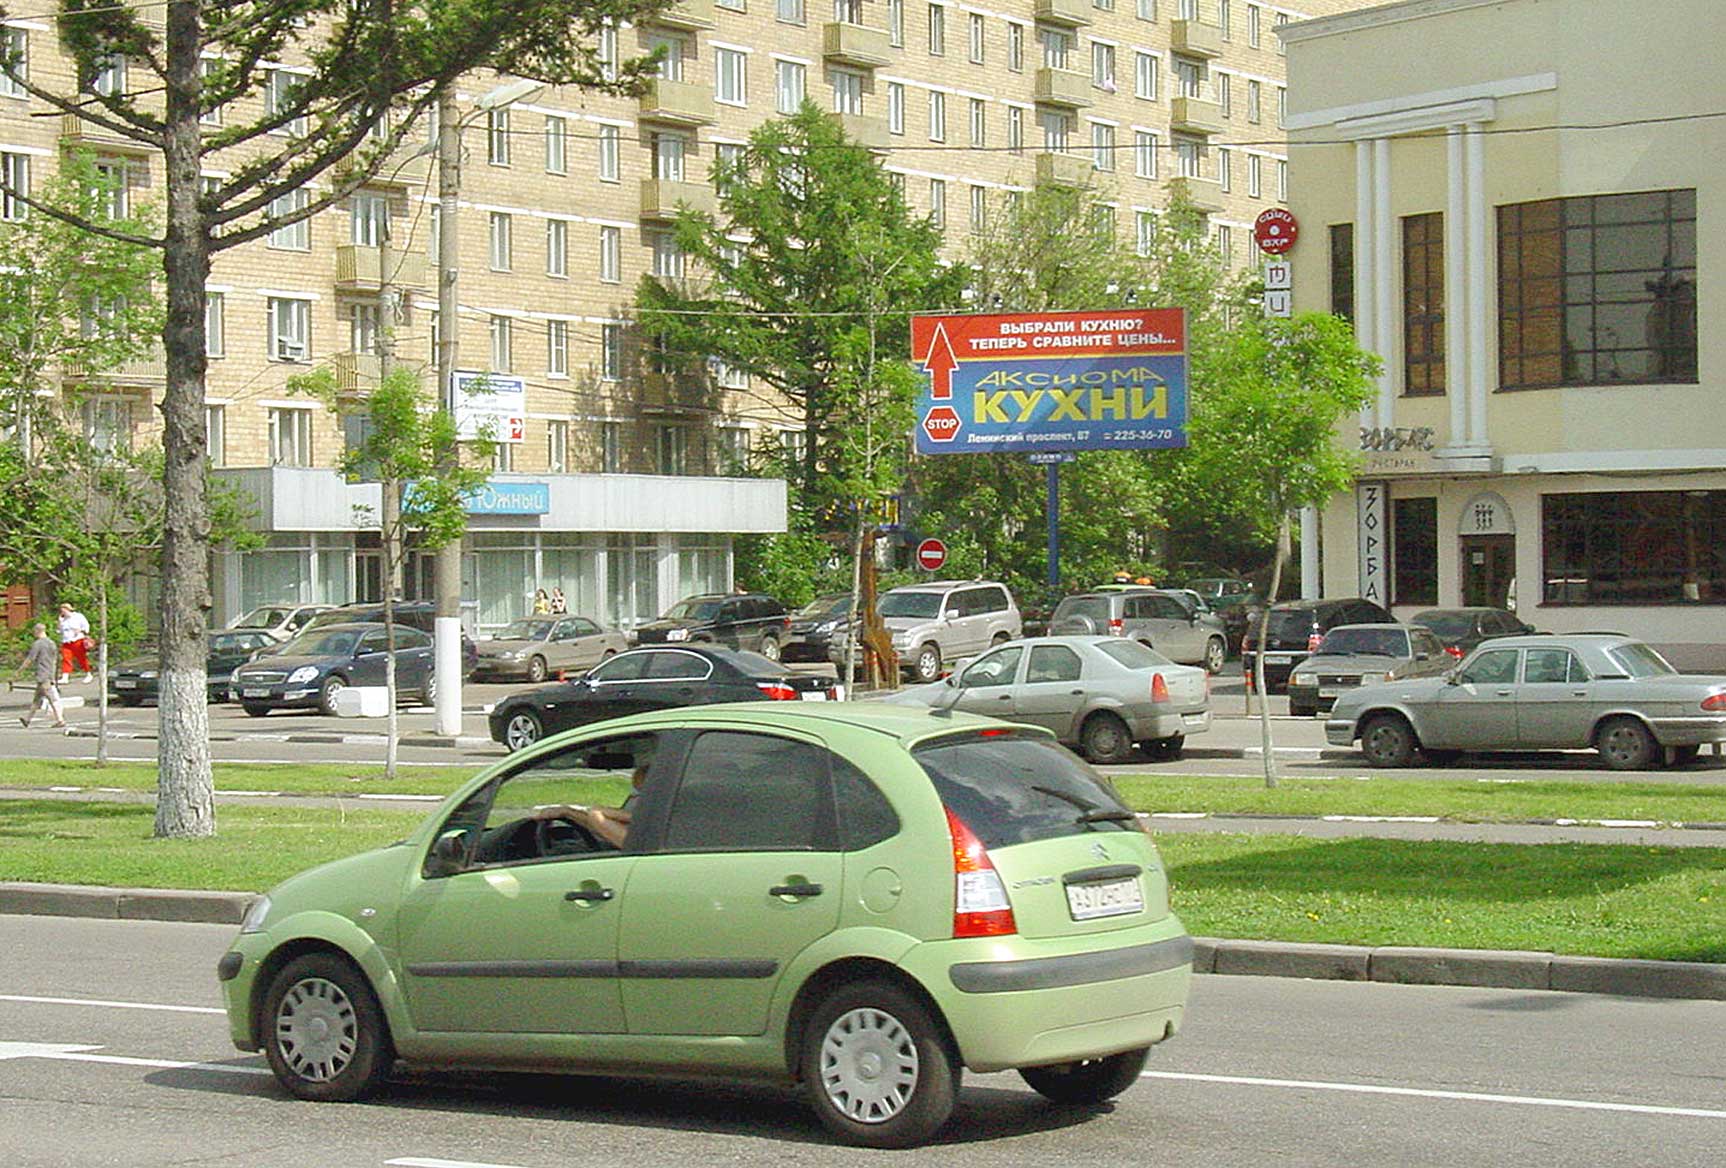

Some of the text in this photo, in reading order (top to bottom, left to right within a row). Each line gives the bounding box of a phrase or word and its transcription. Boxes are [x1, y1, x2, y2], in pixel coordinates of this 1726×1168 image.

[1000, 319, 1143, 335] ВЫБРАЛИ КУХНЮ?
[969, 333, 1176, 350] ТЕПЕРЬ СРАВНИТЕ ЦЕНЫ...
[974, 386, 1168, 423] КУХНИ
[927, 418, 957, 430] STOP
[967, 432, 1024, 444] Ленинский
[1026, 432, 1076, 443] проспект,
[1114, 429, 1172, 441] 225-36-70
[478, 485, 543, 509] Южный
[1365, 487, 1378, 600] ЗОРБА
